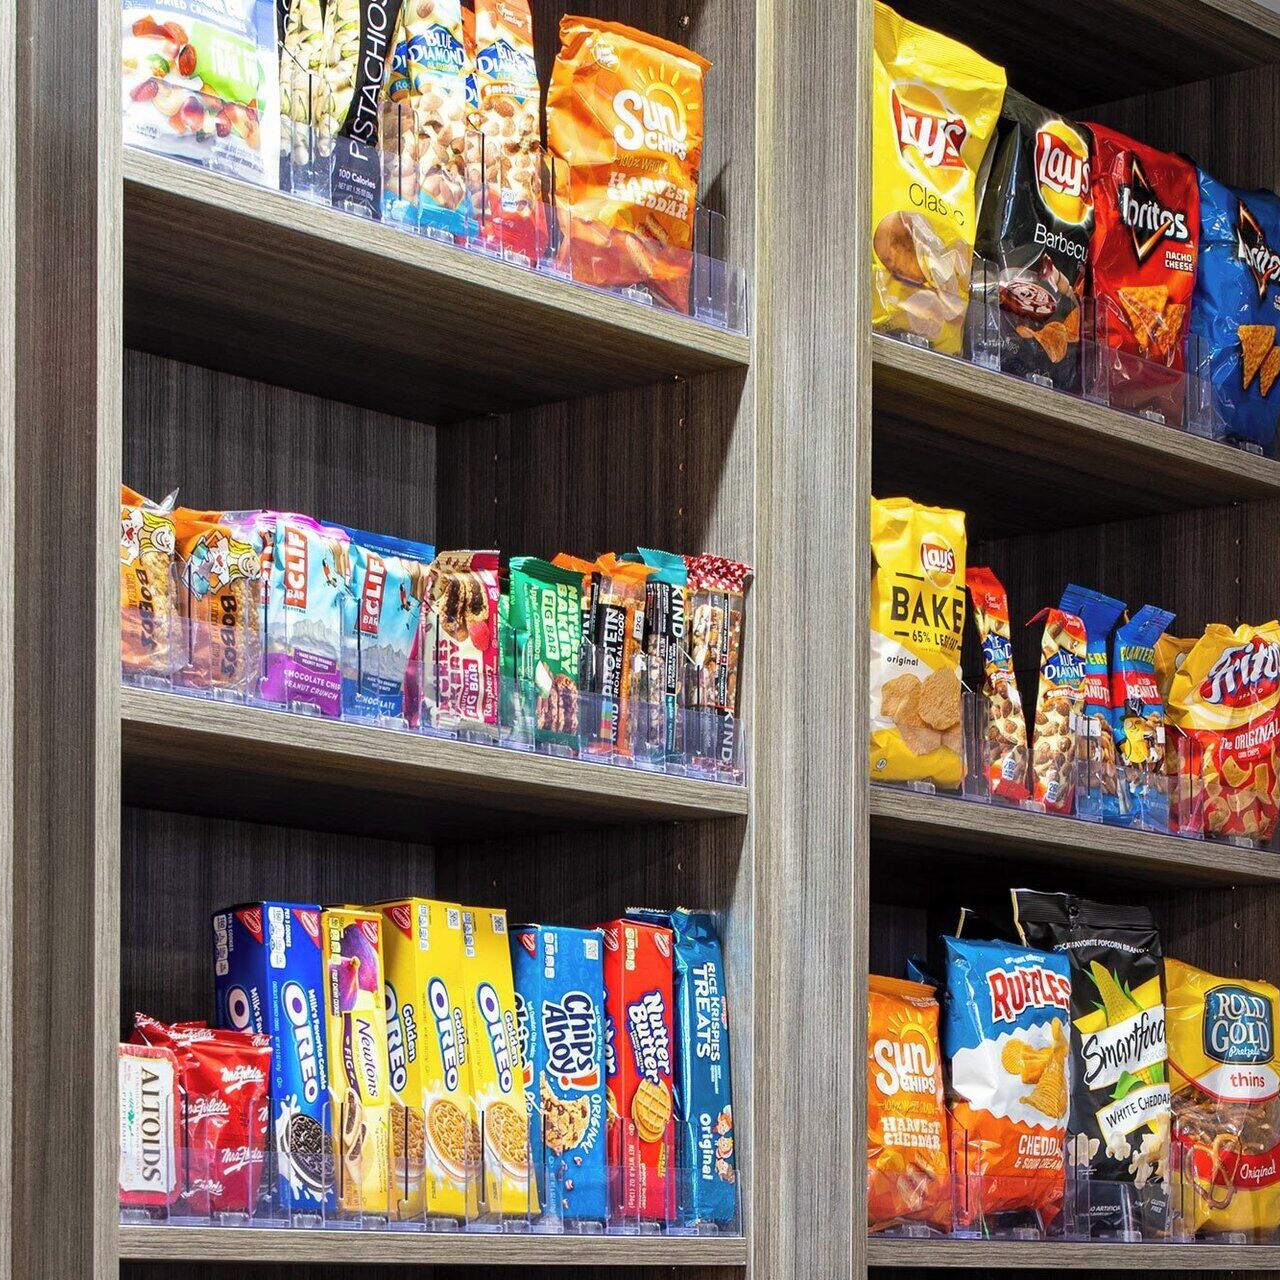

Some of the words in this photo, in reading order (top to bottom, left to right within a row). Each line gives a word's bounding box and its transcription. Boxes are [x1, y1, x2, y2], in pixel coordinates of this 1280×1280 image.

[1042, 132, 1091, 196] Lay's
[1166, 252, 1192, 262] NACHO
[1166, 260, 1193, 272] CHEESE
[362, 557, 386, 617] CLIF
[672, 585, 683, 638] KIND
[887, 655, 919, 667] original
[707, 963, 715, 992] RICE
[987, 968, 1071, 1021] RUFFLES
[1217, 994, 1266, 1019] ROLD
[430, 976, 460, 1092] OREO
[477, 981, 512, 1093] OREO
[504, 1010, 519, 1067] Golden
[562, 992, 597, 1072] Chips
[644, 992, 670, 1079] Nutter
[693, 964, 708, 1058] TREATS
[708, 994, 721, 1062] KRISPIES
[1212, 1020, 1269, 1053] GOLD
[283, 981, 318, 1103] OREO
[355, 1018, 379, 1098] Newtons
[628, 1006, 660, 1084] Butter
[874, 1038, 934, 1096] Sun
[1230, 1072, 1265, 1088] thins
[141, 1066, 166, 1183] ALTOIDS
[579, 1093, 604, 1155] ORIGINAL
[701, 1113, 712, 1180] original
[882, 1117, 940, 1133] HARVEST
[1240, 1164, 1275, 1180] Original
